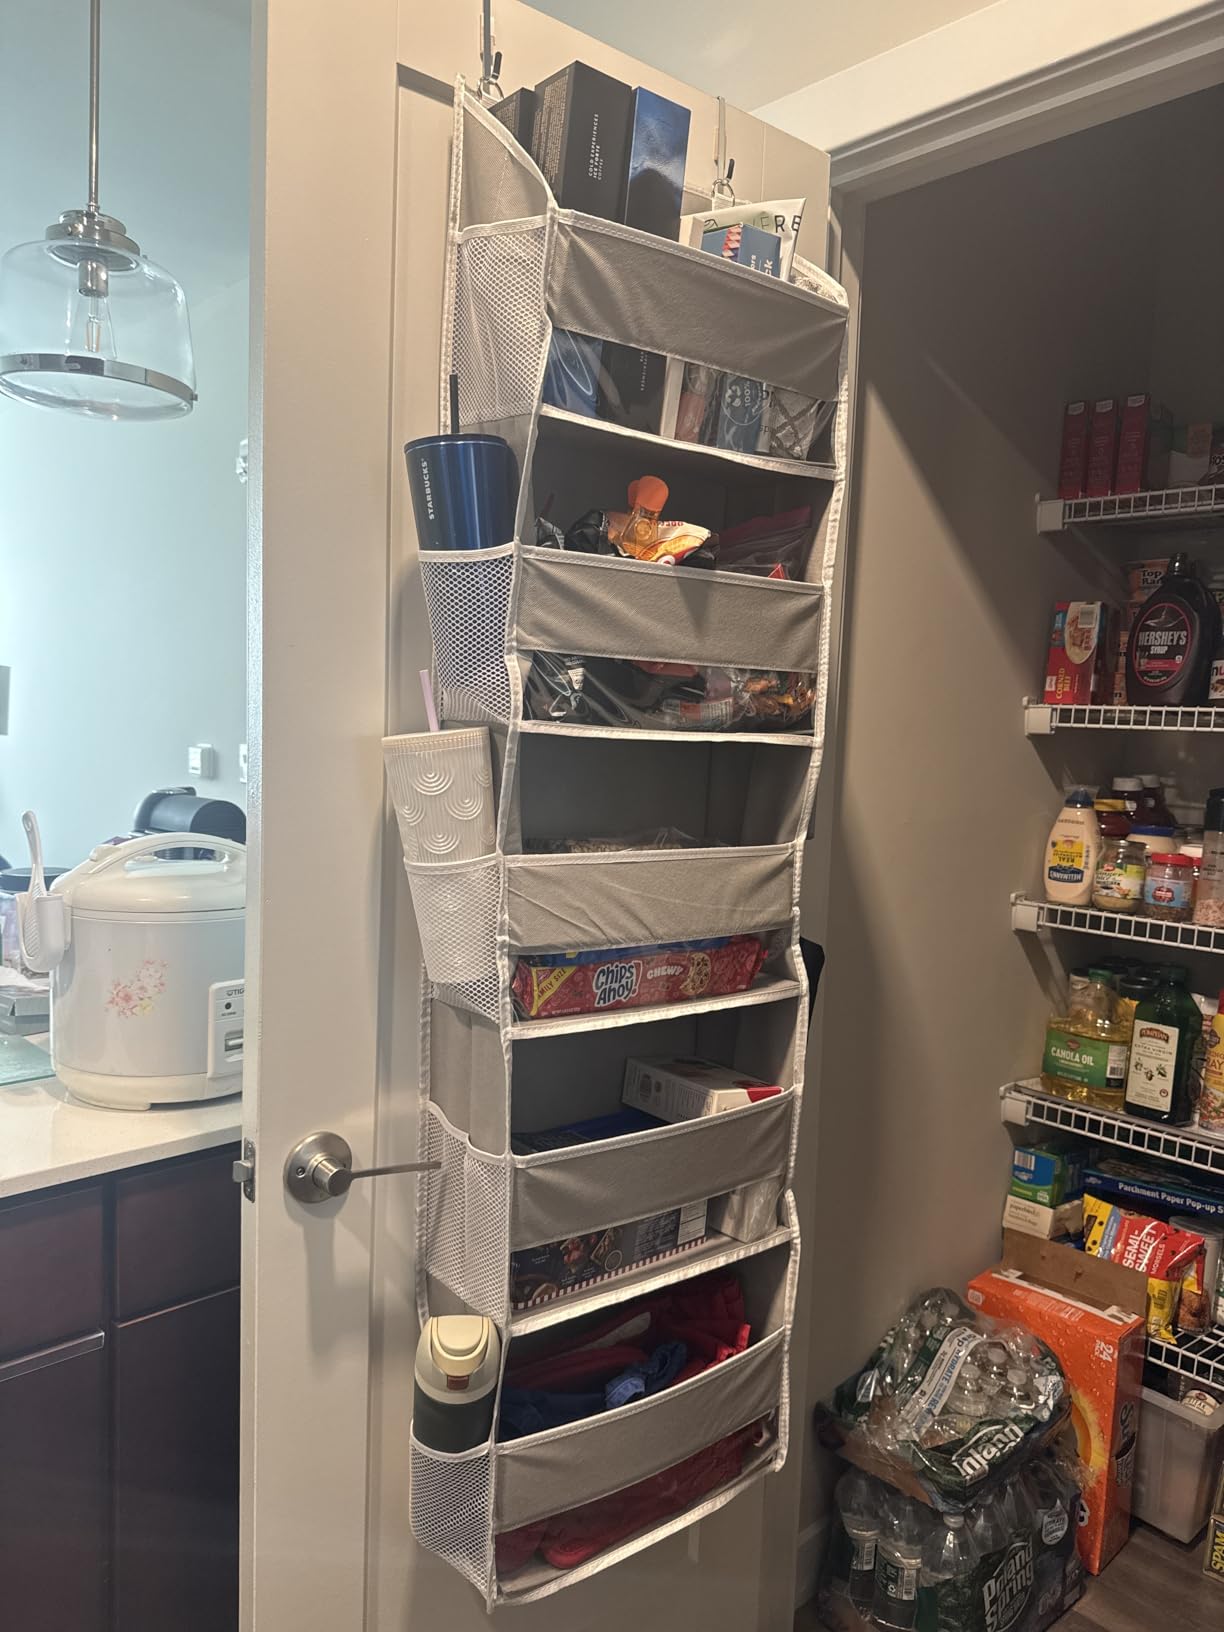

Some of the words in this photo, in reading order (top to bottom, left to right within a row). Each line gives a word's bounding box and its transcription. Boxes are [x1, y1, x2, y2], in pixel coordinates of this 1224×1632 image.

[421, 460, 435, 520] STARBUCKS
[1138, 631, 1188, 646] HERSHEY'S
[594, 961, 635, 992] Chips
[646, 965, 684, 979] CHEWY
[595, 974, 641, 1006] Ahoy!
[1051, 1047, 1080, 1063] CANOLA
[1081, 1055, 1095, 1066] OIL
[1118, 1182, 1160, 1199] Parchment
[1160, 1192, 1185, 1205] Paper
[1186, 1197, 1216, 1214] Pop-up
[1122, 1229, 1140, 1269] SEMI-
[1135, 1226, 1157, 1273] SWEET
[1100, 1341, 1114, 1362] 24
[982, 1541, 1033, 1615] Poland
